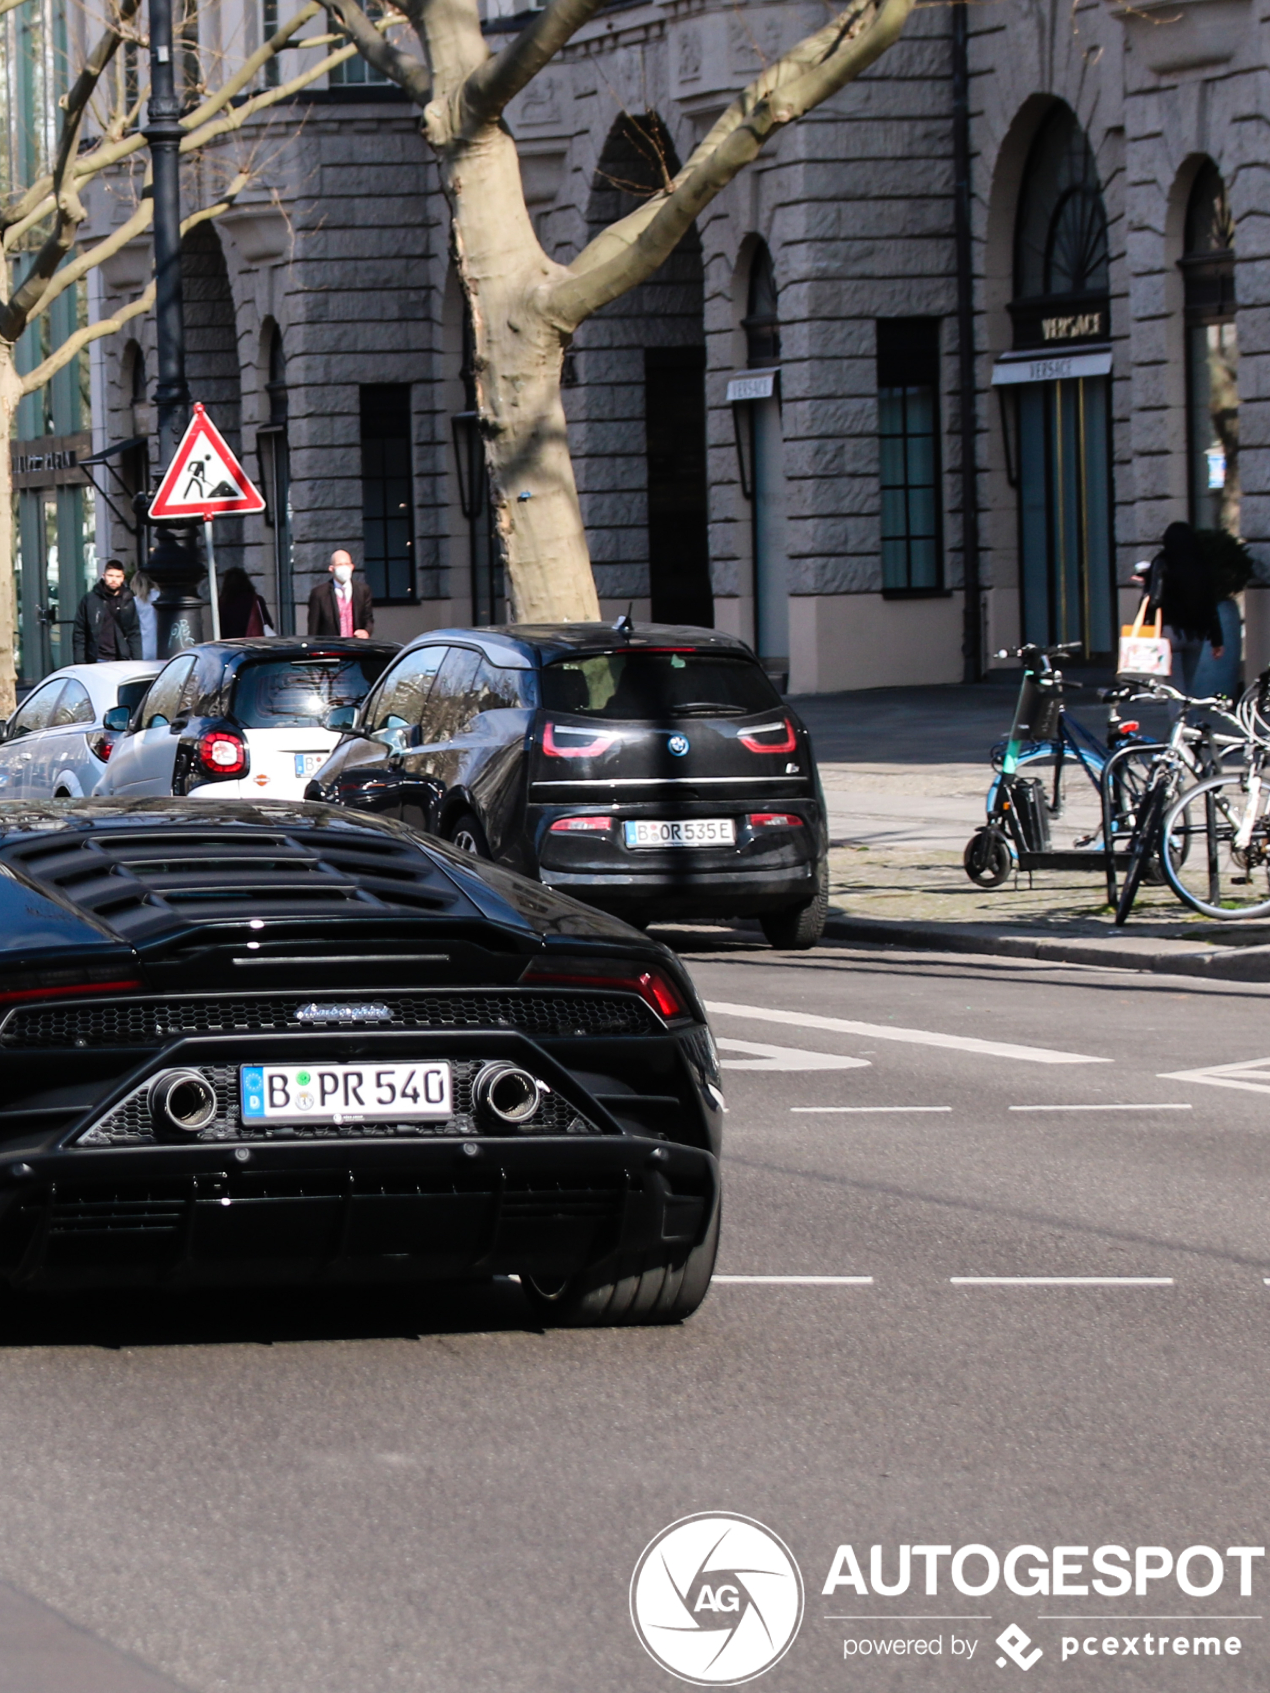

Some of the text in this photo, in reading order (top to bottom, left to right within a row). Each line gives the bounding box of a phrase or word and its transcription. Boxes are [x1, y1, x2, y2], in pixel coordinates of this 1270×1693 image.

[305, 757, 315, 771] B
[637, 822, 731, 841] B OR 535 E
[268, 1070, 444, 1109] B PR 540
[249, 1095, 260, 1109] D
